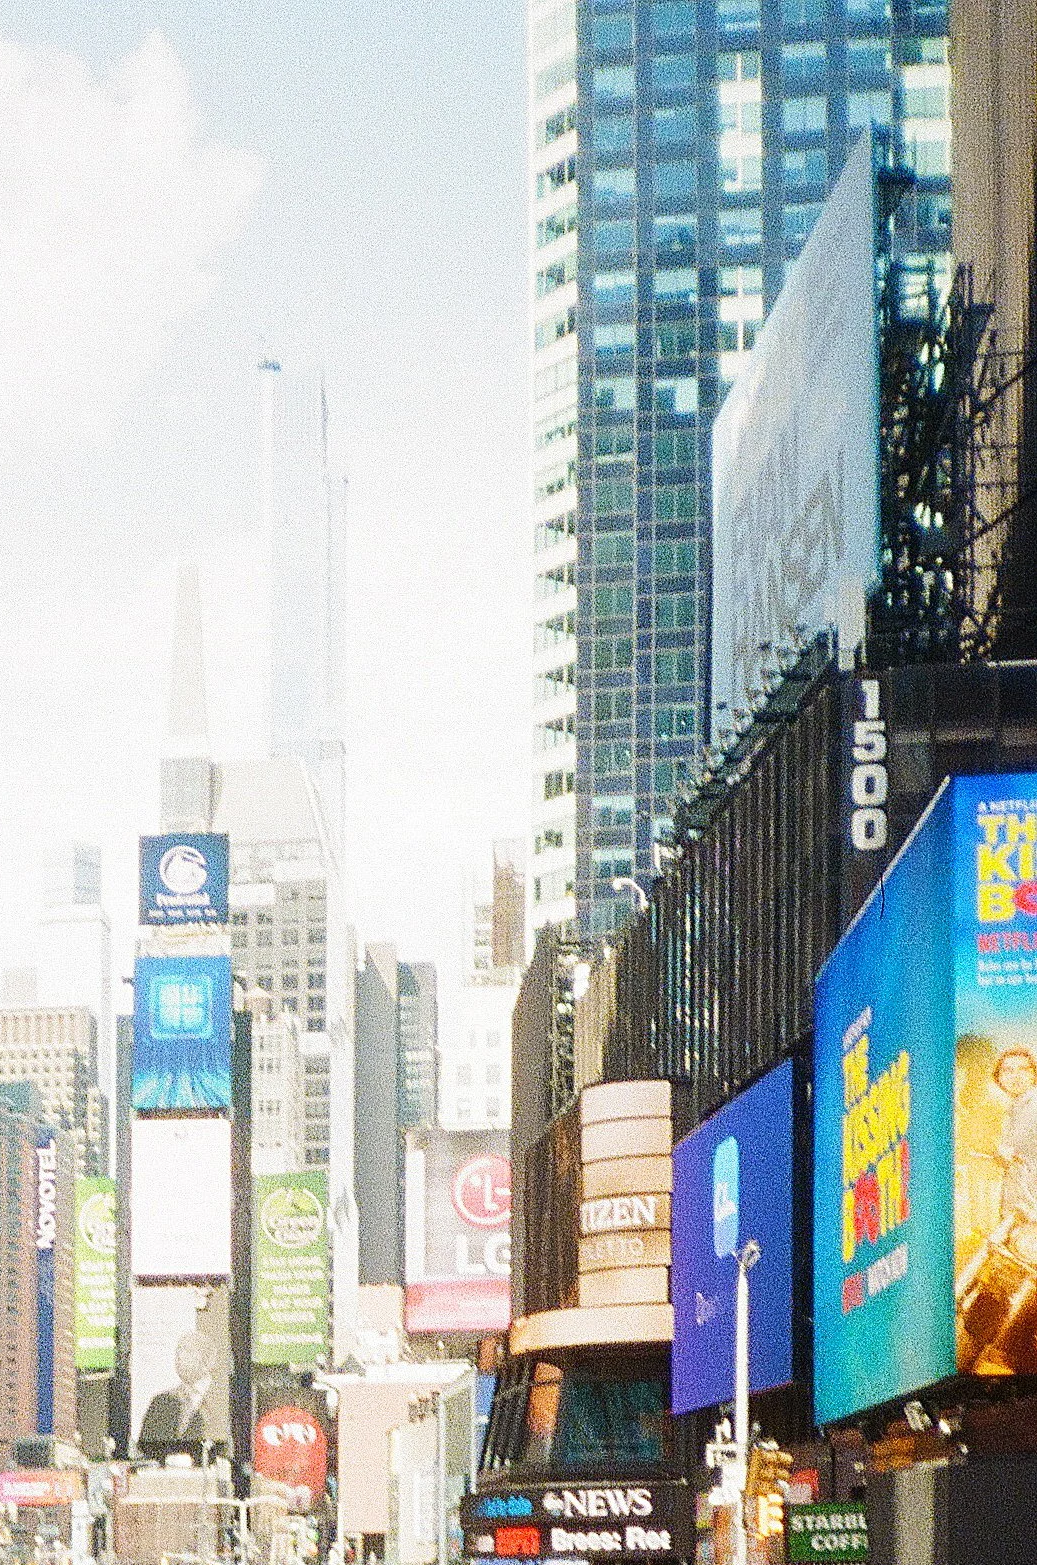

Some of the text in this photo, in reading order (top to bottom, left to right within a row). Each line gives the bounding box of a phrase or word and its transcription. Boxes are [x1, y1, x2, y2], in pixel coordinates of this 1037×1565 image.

[851, 679, 888, 851] 1500
[36, 1138, 56, 1250] NOVOTEL
[455, 1231, 512, 1276] LG
[563, 1488, 653, 1518] NEWS
